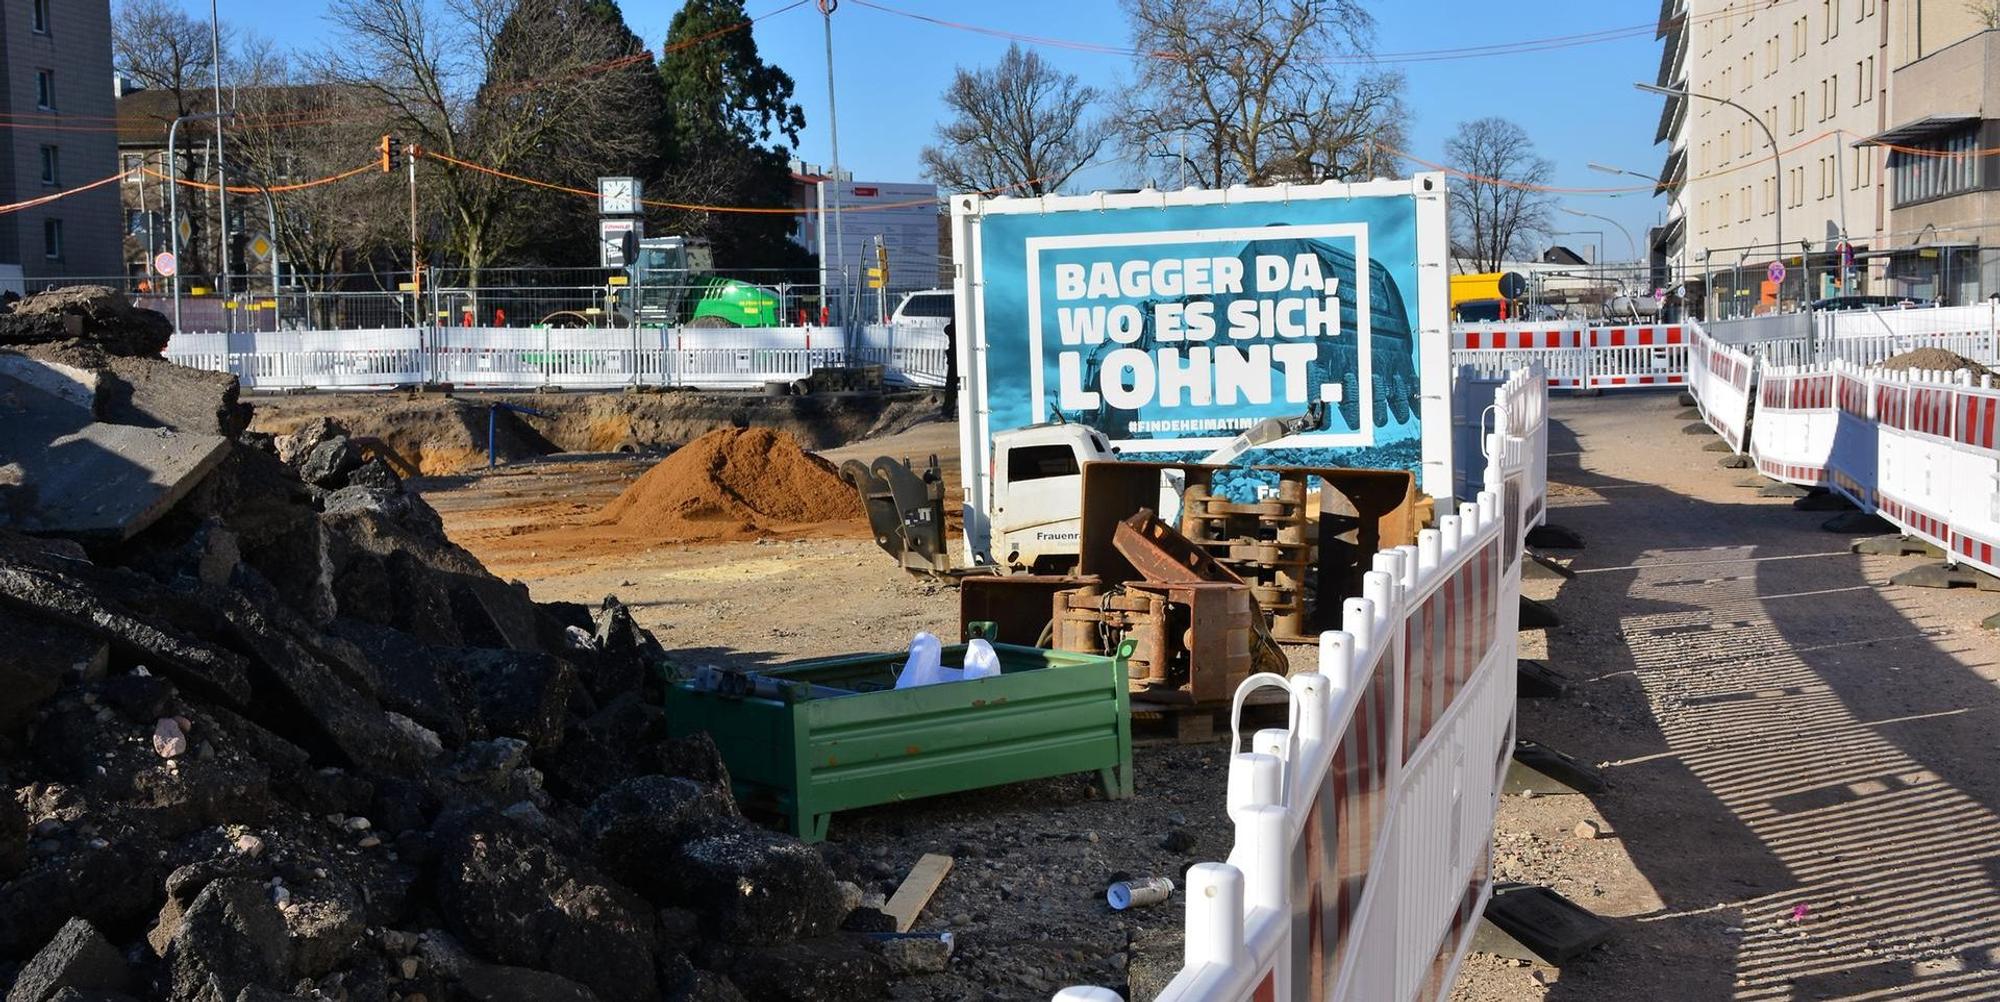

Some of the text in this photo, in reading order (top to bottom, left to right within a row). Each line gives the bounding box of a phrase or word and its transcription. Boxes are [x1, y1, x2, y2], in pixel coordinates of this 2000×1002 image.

[1055, 253, 1338, 300] BAGGER DA,
[1057, 296, 1342, 346] WO ES SICH
[1058, 343, 1343, 411] LOHNT.
[1036, 531, 1081, 541] Frauenr
